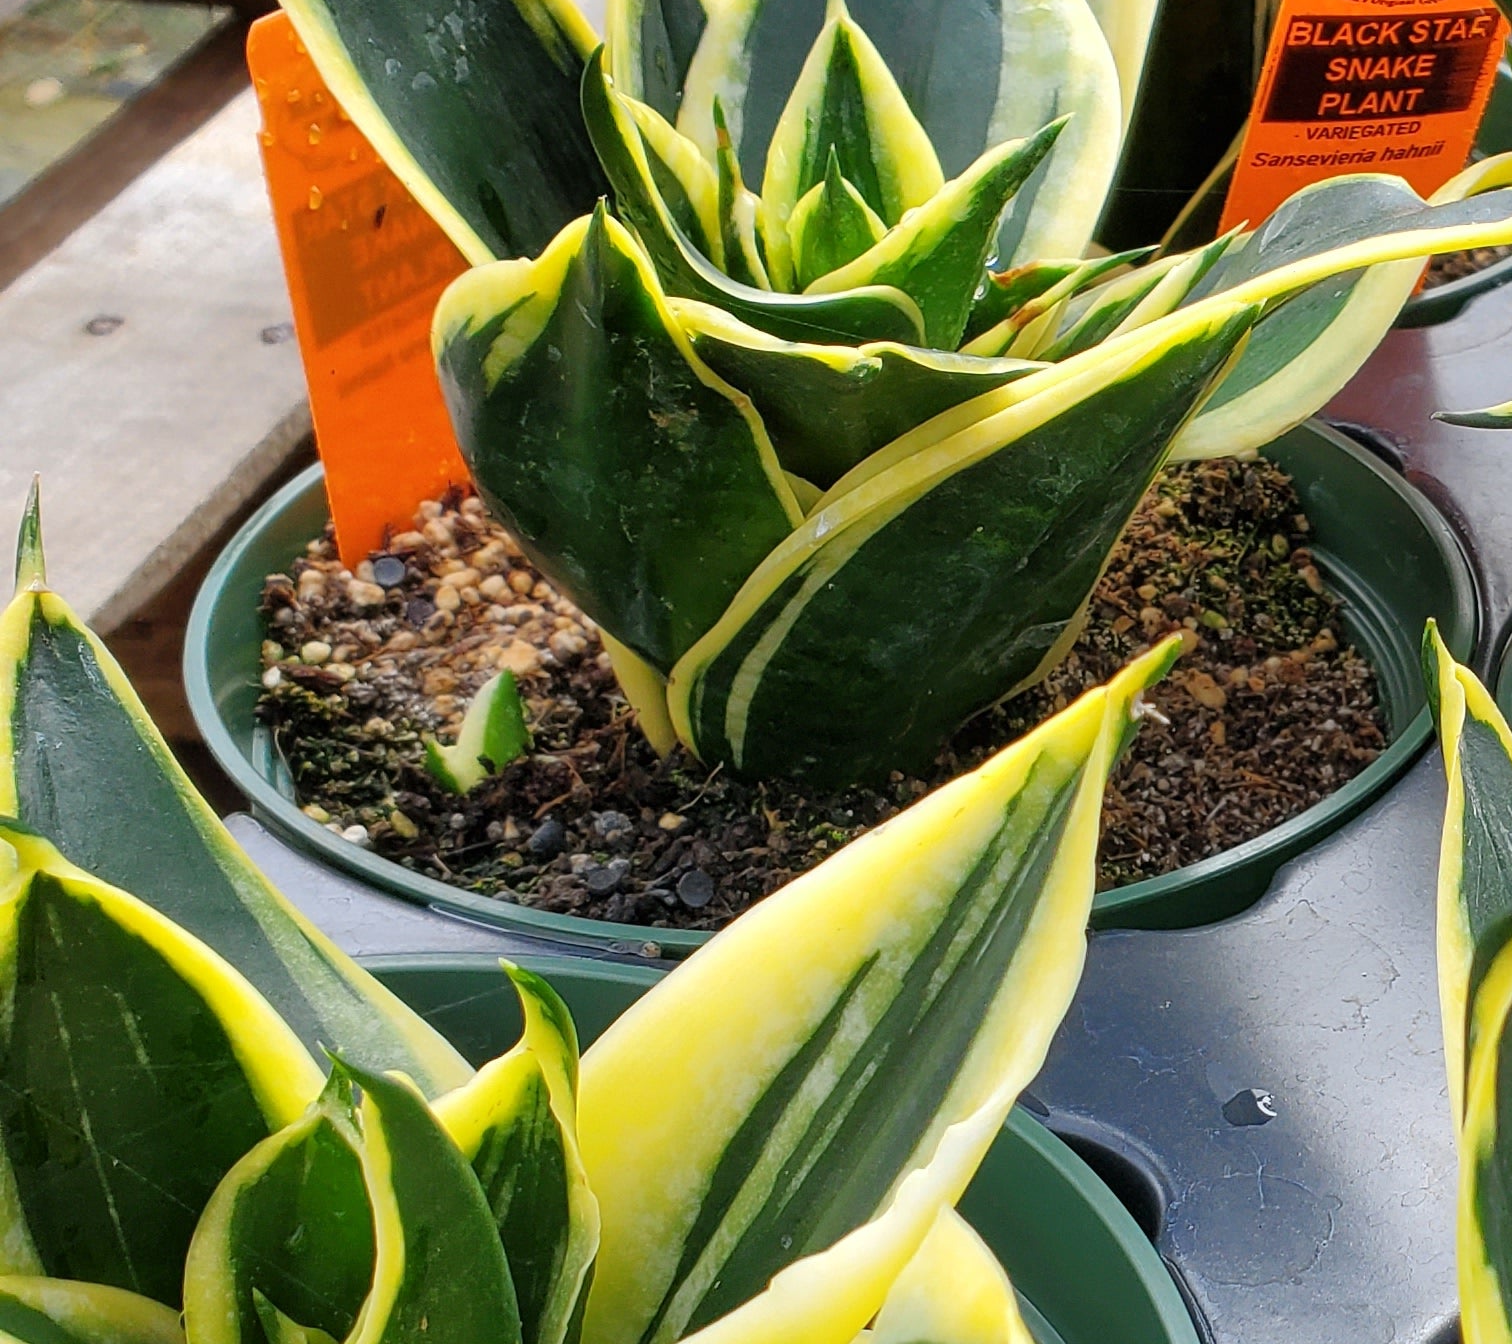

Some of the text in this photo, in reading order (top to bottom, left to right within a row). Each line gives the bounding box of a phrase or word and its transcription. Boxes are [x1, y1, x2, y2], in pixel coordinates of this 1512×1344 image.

[1287, 21, 1404, 46] BLACK
[1325, 54, 1436, 82] SNAKE
[1317, 88, 1424, 116] PLANT
[1306, 121, 1422, 140] VARIEGATED
[1250, 140, 1446, 168] Sansevieria hahnii
